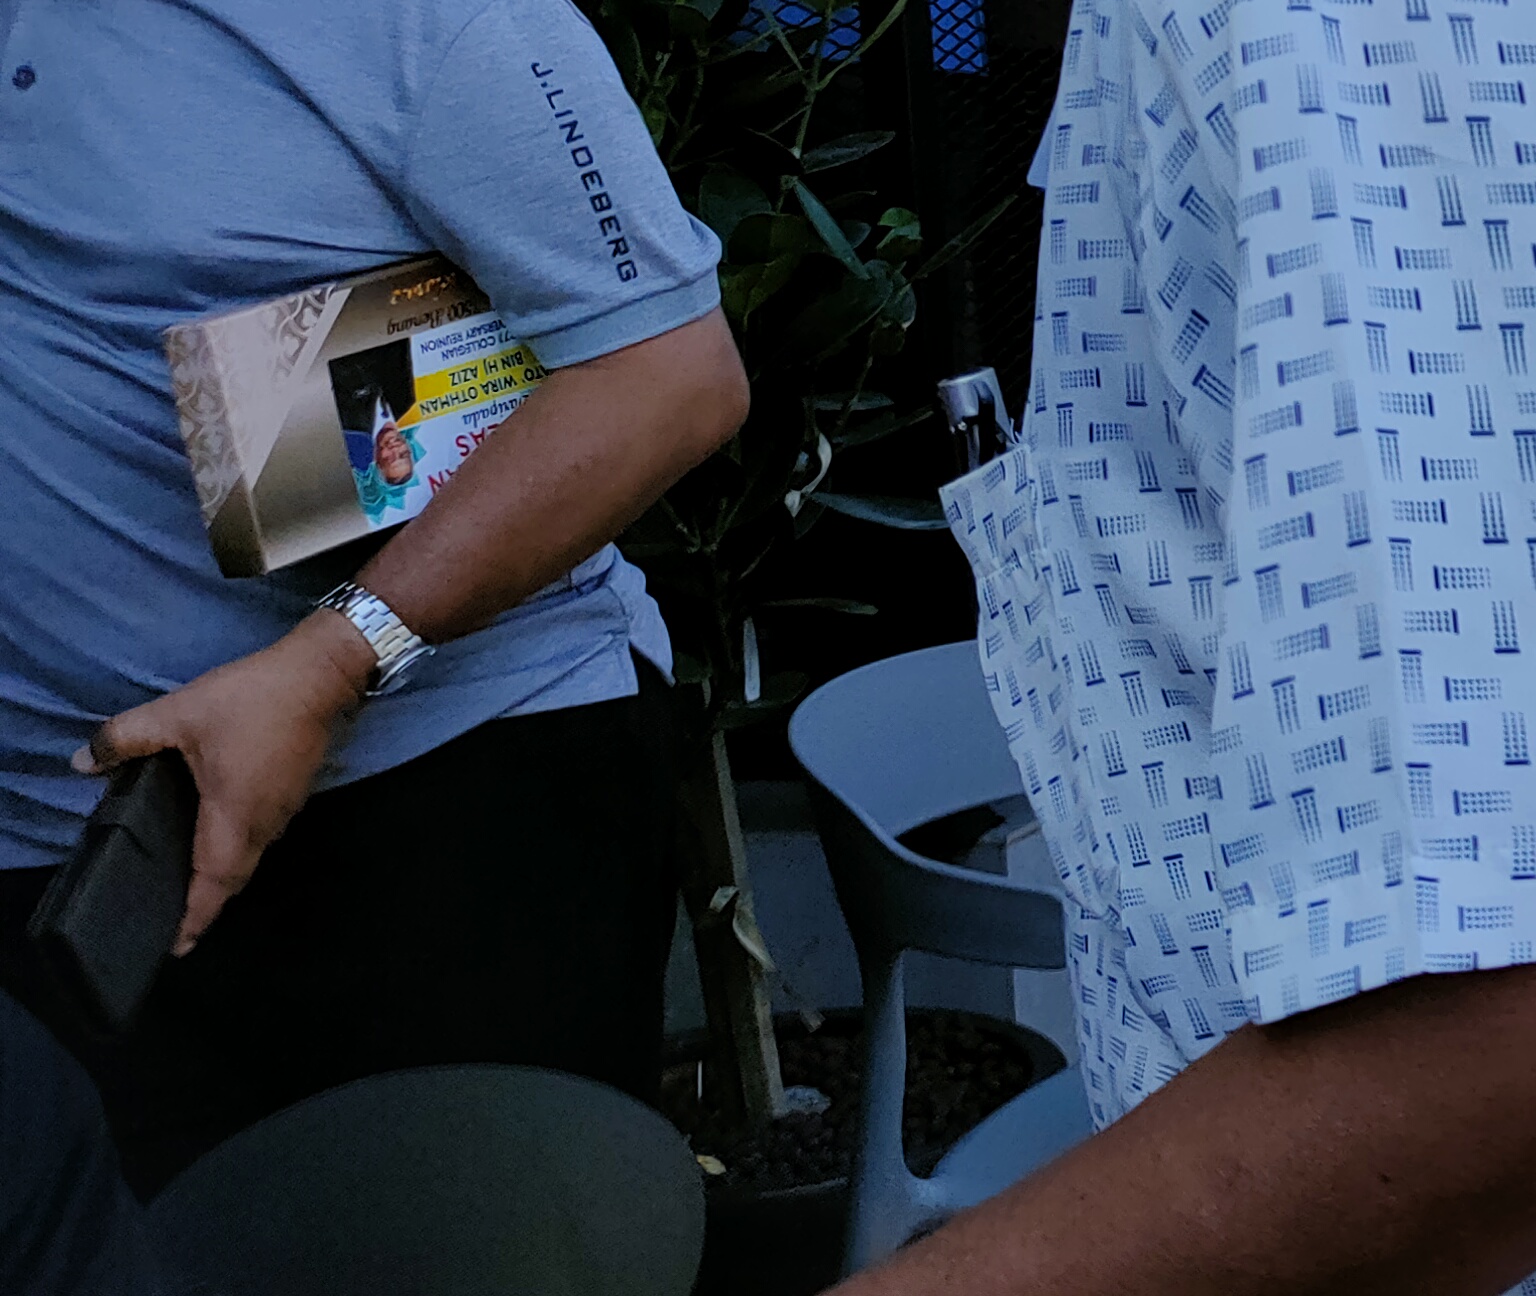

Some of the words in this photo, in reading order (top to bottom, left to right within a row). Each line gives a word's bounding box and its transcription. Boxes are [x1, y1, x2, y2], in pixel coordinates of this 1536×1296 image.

[530, 61, 639, 284] J.LINDEBERG
[420, 329, 465, 355] REUNION
[465, 319, 508, 342] VERSARY
[440, 336, 497, 362] COLLEGIAN
[501, 350, 525, 369] BIN
[448, 364, 479, 388] AZIZ
[483, 357, 499, 377] HJ
[479, 374, 518, 396] WIRA
[420, 385, 479, 416] OTHMAN
